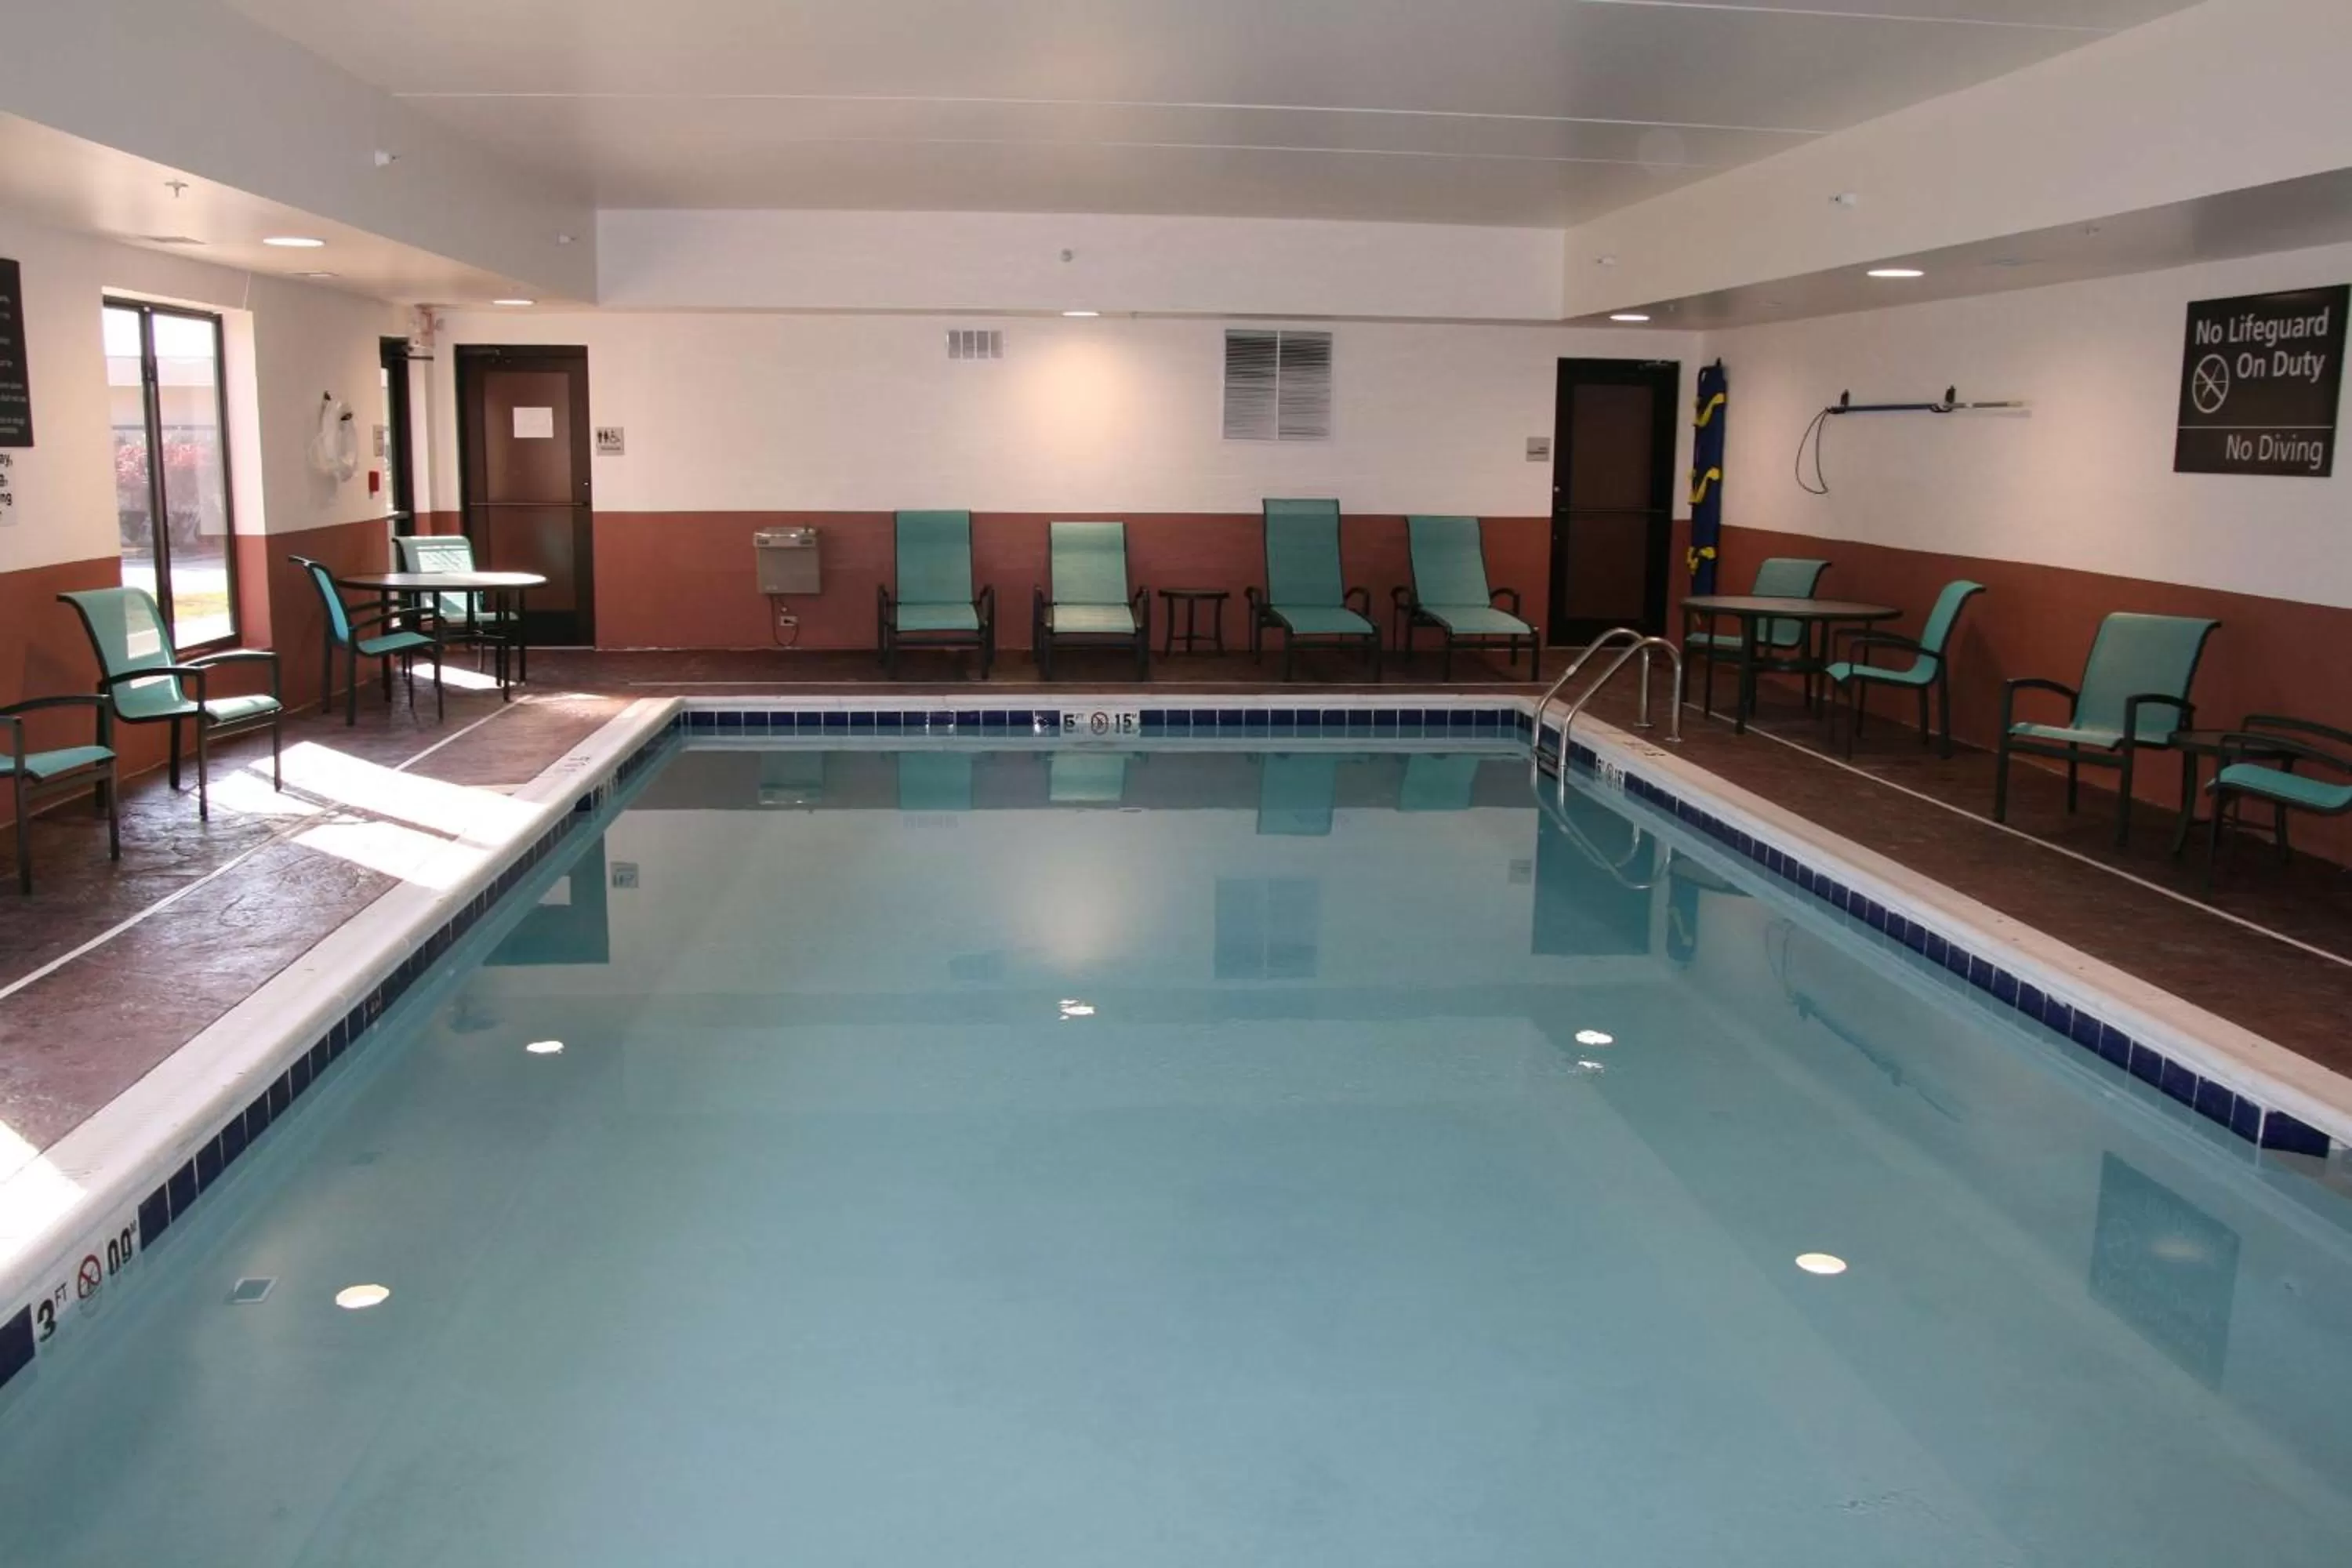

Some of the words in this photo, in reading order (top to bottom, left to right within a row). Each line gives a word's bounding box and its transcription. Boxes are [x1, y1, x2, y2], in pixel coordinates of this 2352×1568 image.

[2195, 319, 2223, 345] No
[2229, 307, 2330, 347] Lifeguard
[2237, 352, 2266, 379] On
[2272, 350, 2326, 383] Duty
[2226, 434, 2252, 461] No
[2258, 434, 2324, 470] Diving
